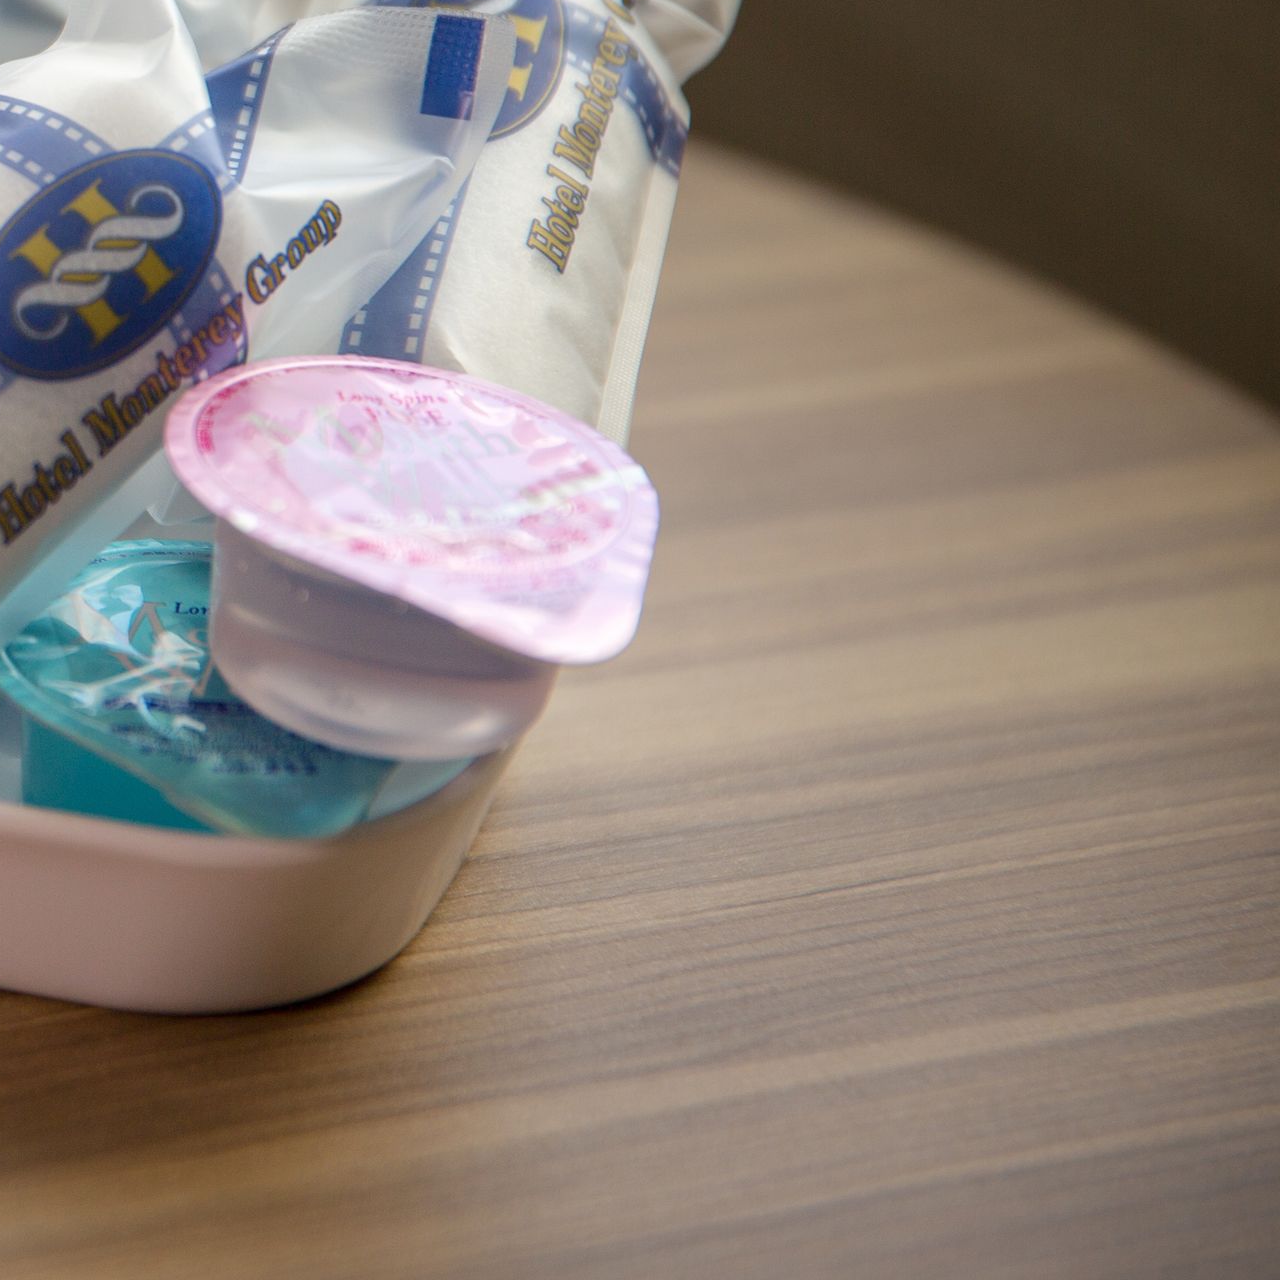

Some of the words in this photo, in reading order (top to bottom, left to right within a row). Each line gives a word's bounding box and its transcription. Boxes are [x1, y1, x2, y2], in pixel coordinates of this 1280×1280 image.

[552, 16, 638, 181] Monterey
[526, 164, 590, 274] Hotel
[81, 291, 246, 459] Monterey
[244, 198, 342, 305] Group
